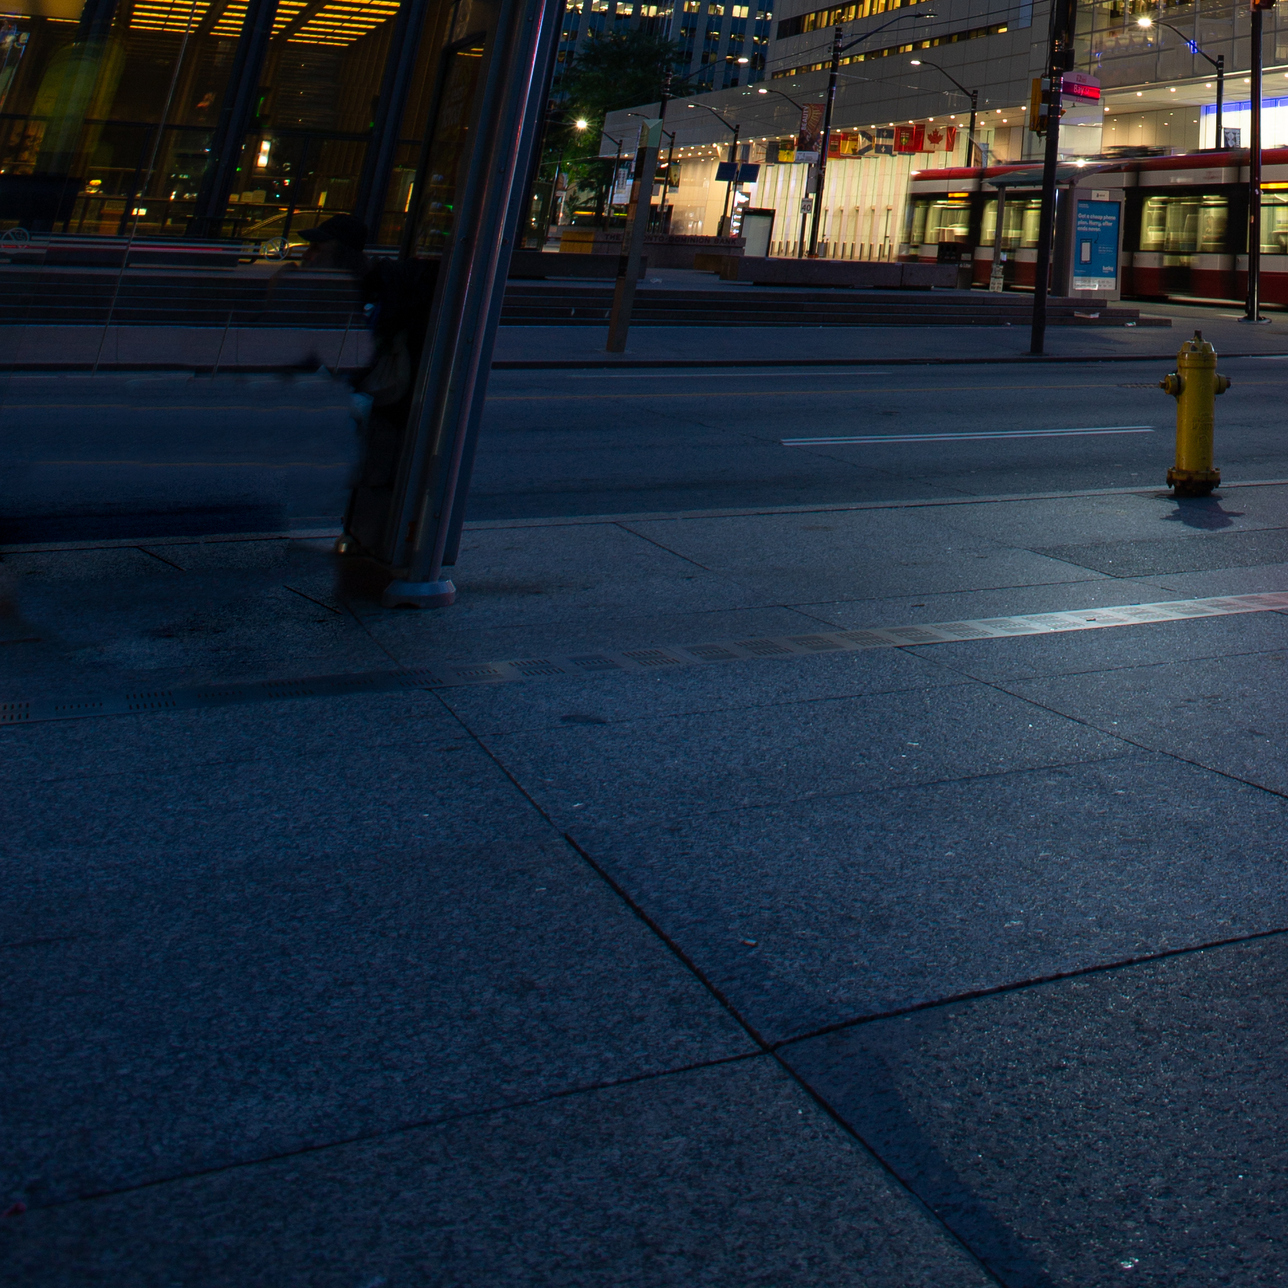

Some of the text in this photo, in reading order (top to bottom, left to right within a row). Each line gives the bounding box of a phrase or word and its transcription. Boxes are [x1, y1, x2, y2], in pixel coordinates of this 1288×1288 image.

[1073, 84, 1084, 96] Bay
[801, 105, 809, 131] BEAUTY
[801, 204, 812, 212] 40
[605, 233, 621, 241] THE
[714, 237, 737, 245] BANK
